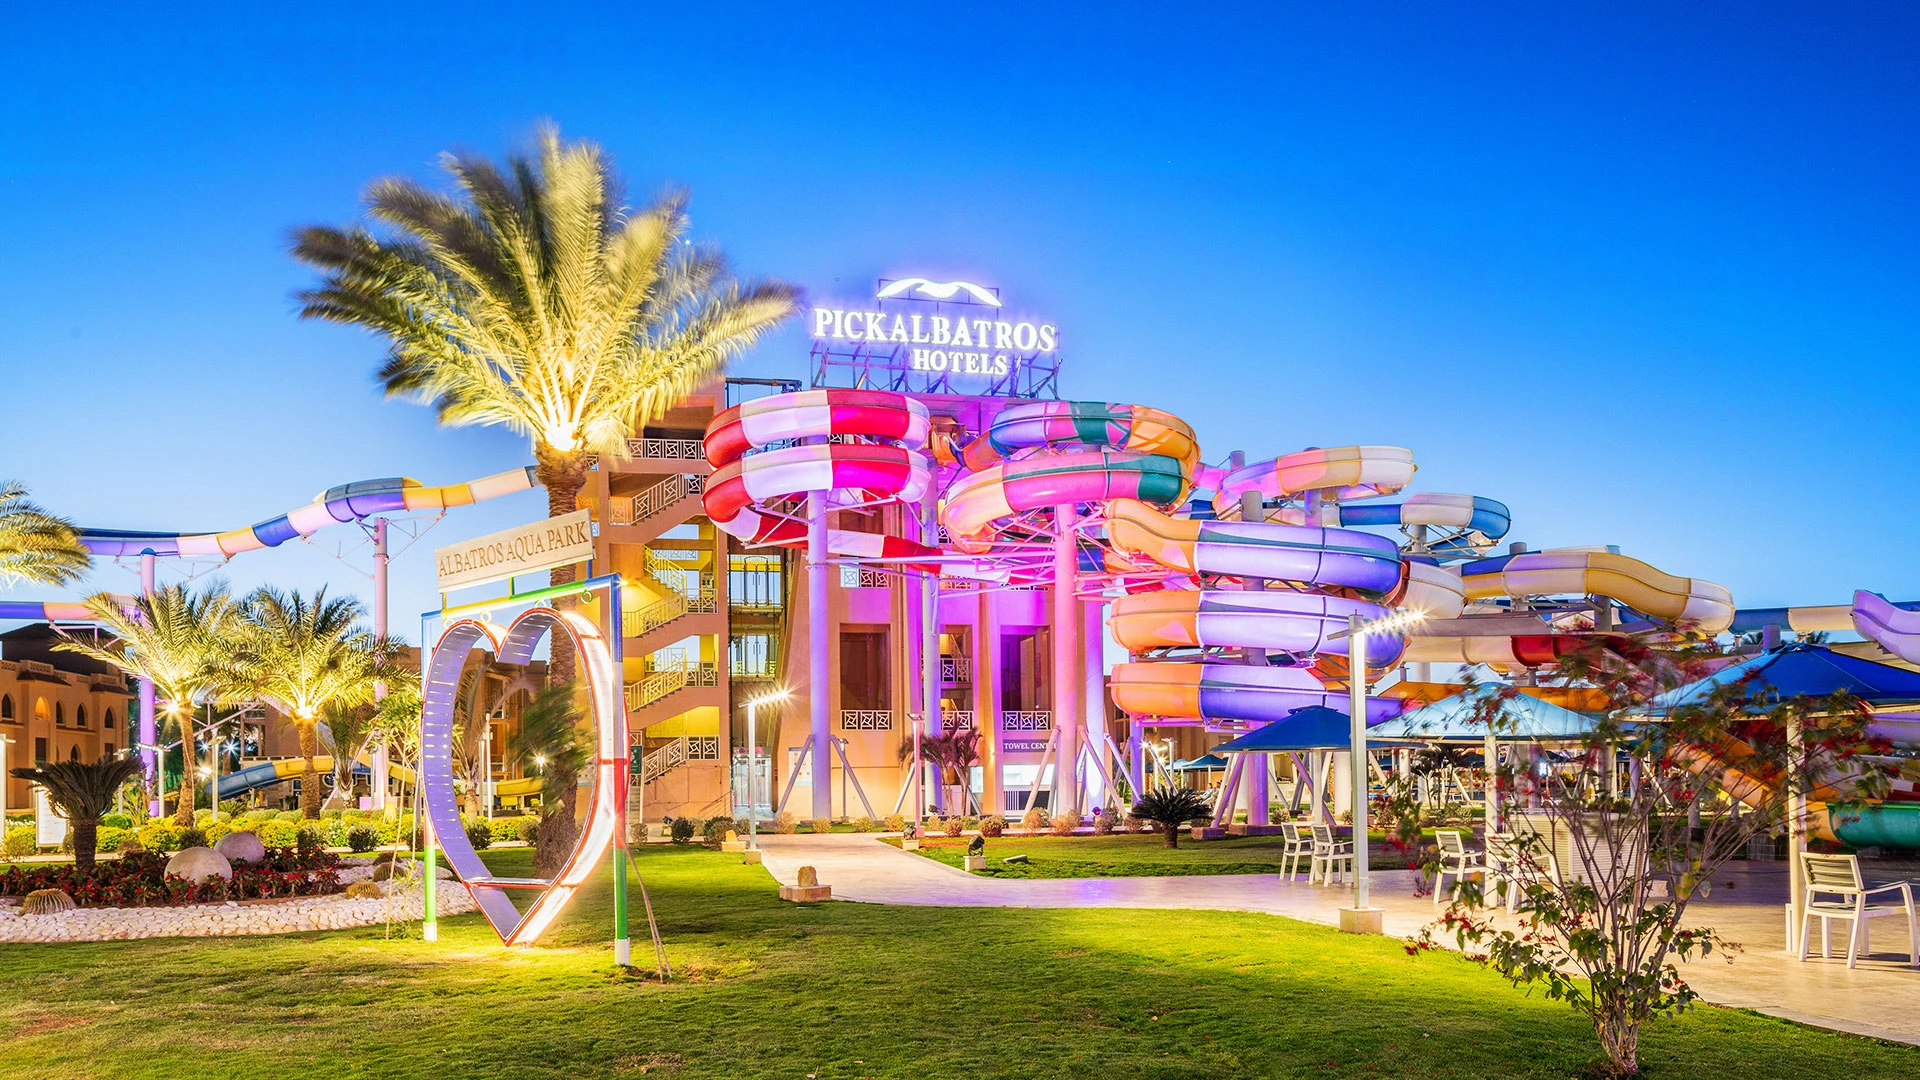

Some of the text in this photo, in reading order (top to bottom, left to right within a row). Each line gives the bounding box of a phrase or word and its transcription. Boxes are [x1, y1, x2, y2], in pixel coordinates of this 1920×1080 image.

[814, 308, 1056, 352] PICKALBATROS
[912, 348, 1007, 375] HOTELS
[439, 521, 589, 577] ALBATROS AQUA PARK
